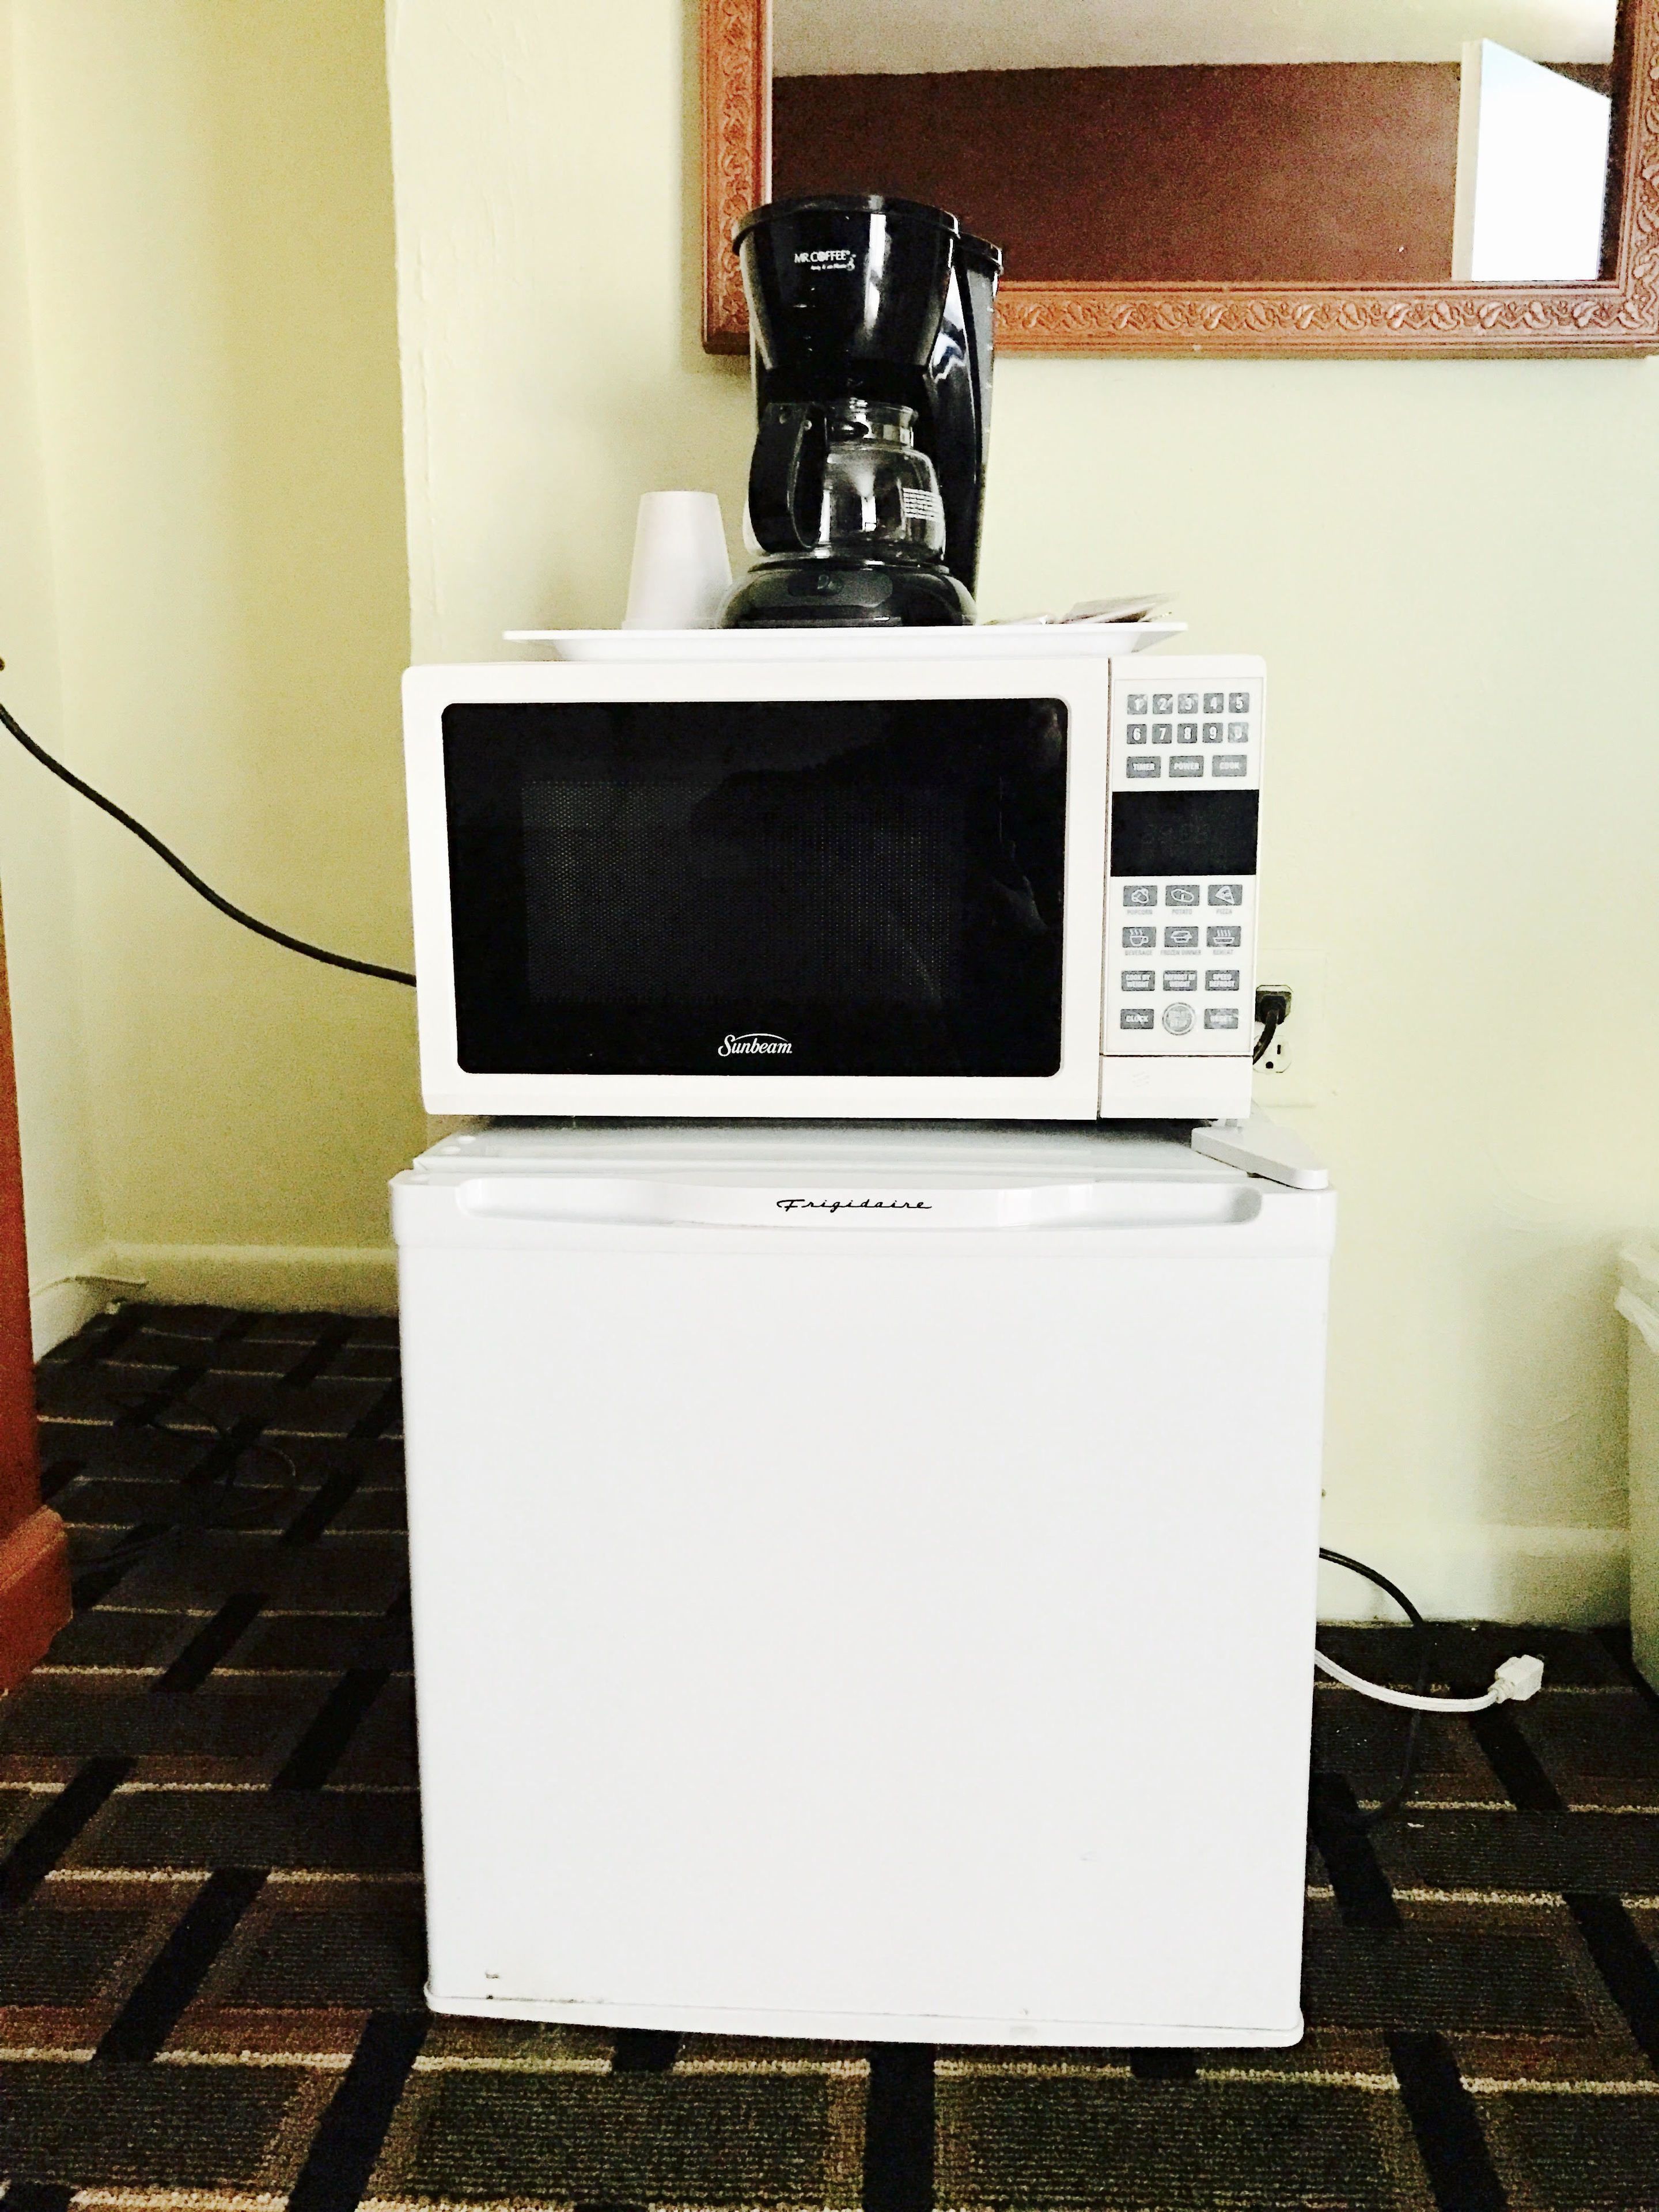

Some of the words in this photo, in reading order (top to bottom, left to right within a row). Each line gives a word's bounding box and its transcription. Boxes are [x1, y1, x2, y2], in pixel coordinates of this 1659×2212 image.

[1134, 698, 1142, 711] 1
[1158, 698, 1167, 711] 2
[1184, 697, 1192, 710] 3
[1210, 696, 1217, 710] 4
[1236, 696, 1243, 710] 5
[1132, 727, 1141, 741] 6
[1159, 727, 1166, 740] 7
[1184, 726, 1192, 740] 8
[1209, 726, 1217, 740] 9
[1132, 763, 1155, 771] TIMER
[1174, 762, 1200, 770] POWER
[718, 1033, 793, 1056] Sunbeam
[777, 1199, 932, 1213] Frigidaire
